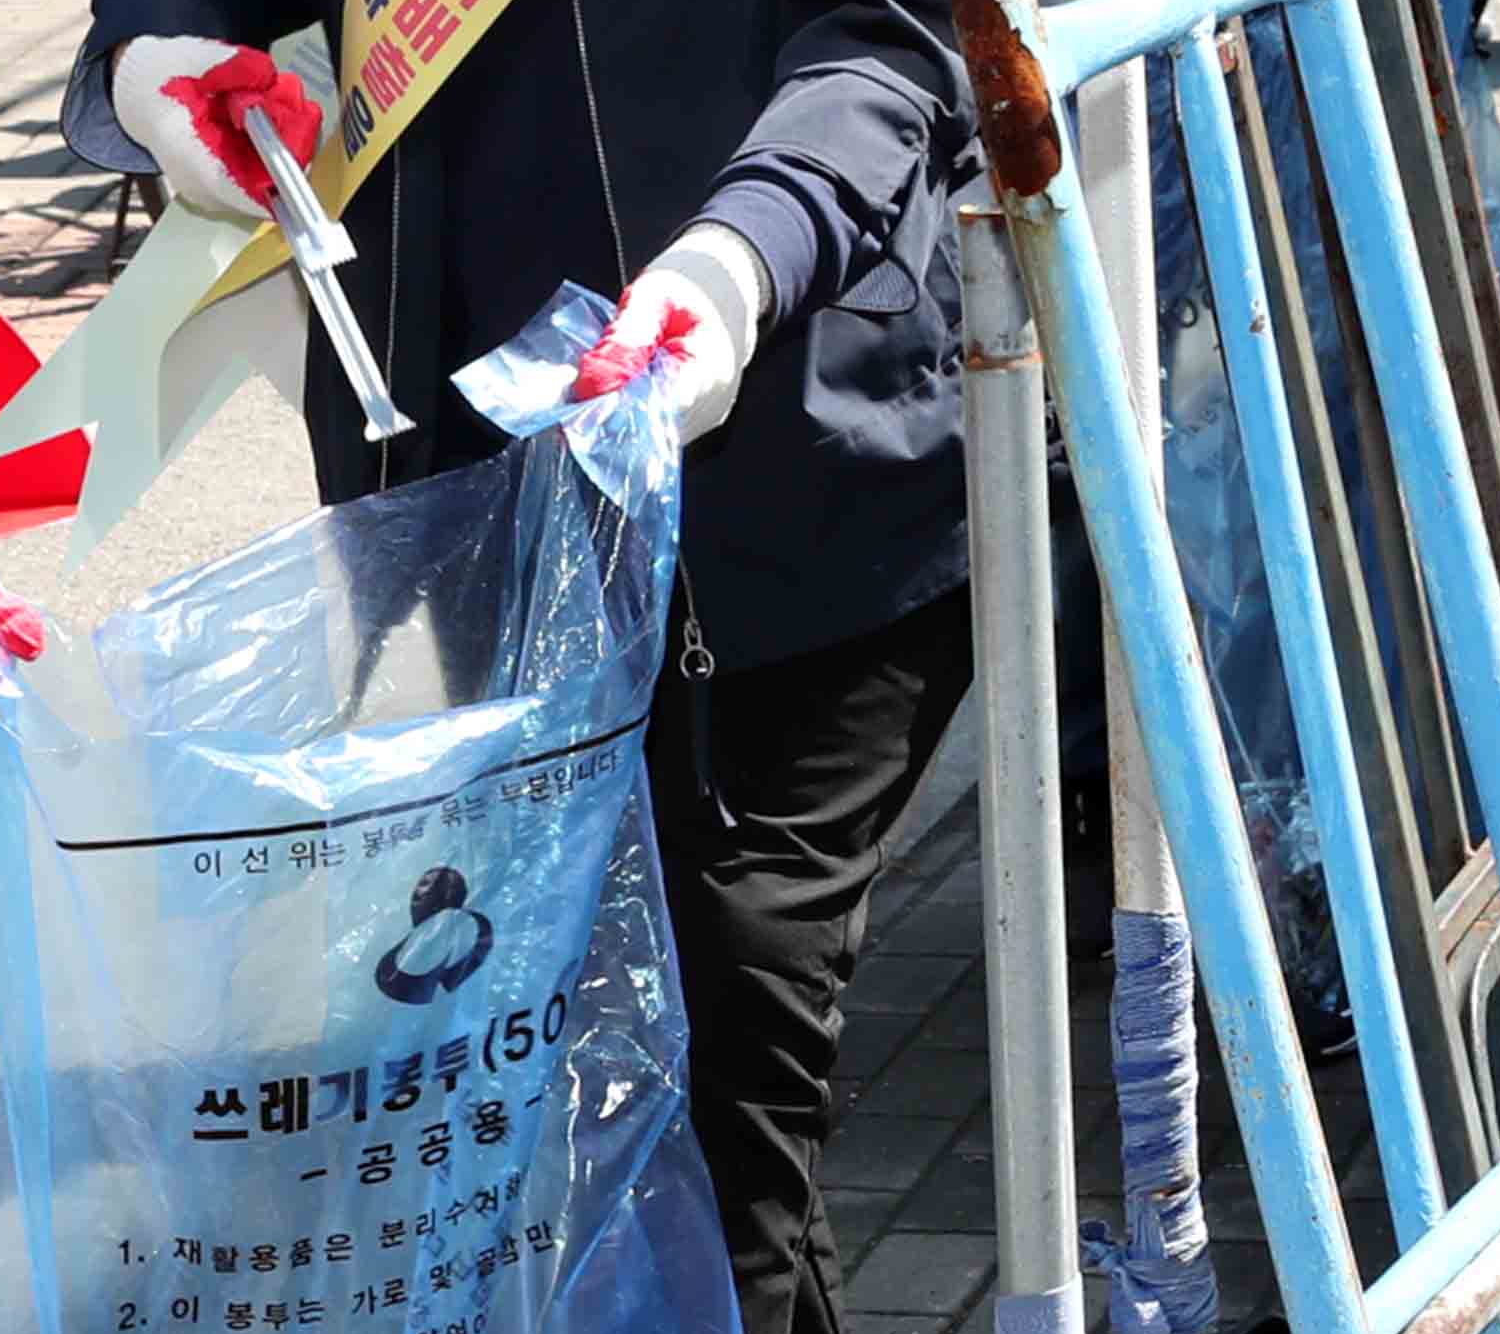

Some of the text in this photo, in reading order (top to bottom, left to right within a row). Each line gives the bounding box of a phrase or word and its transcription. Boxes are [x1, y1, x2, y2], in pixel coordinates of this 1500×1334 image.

[194, 850, 222, 878] 이
[241, 848, 269, 874] 선
[289, 839, 345, 869] 위는
[118, 1242, 145, 1266] 1.
[173, 1232, 355, 1274] 재활용품은
[117, 1302, 149, 1332] 2.
[170, 1295, 200, 1324] 이
[223, 1297, 328, 1332] 봉투는
[351, 1277, 409, 1317] 가로
